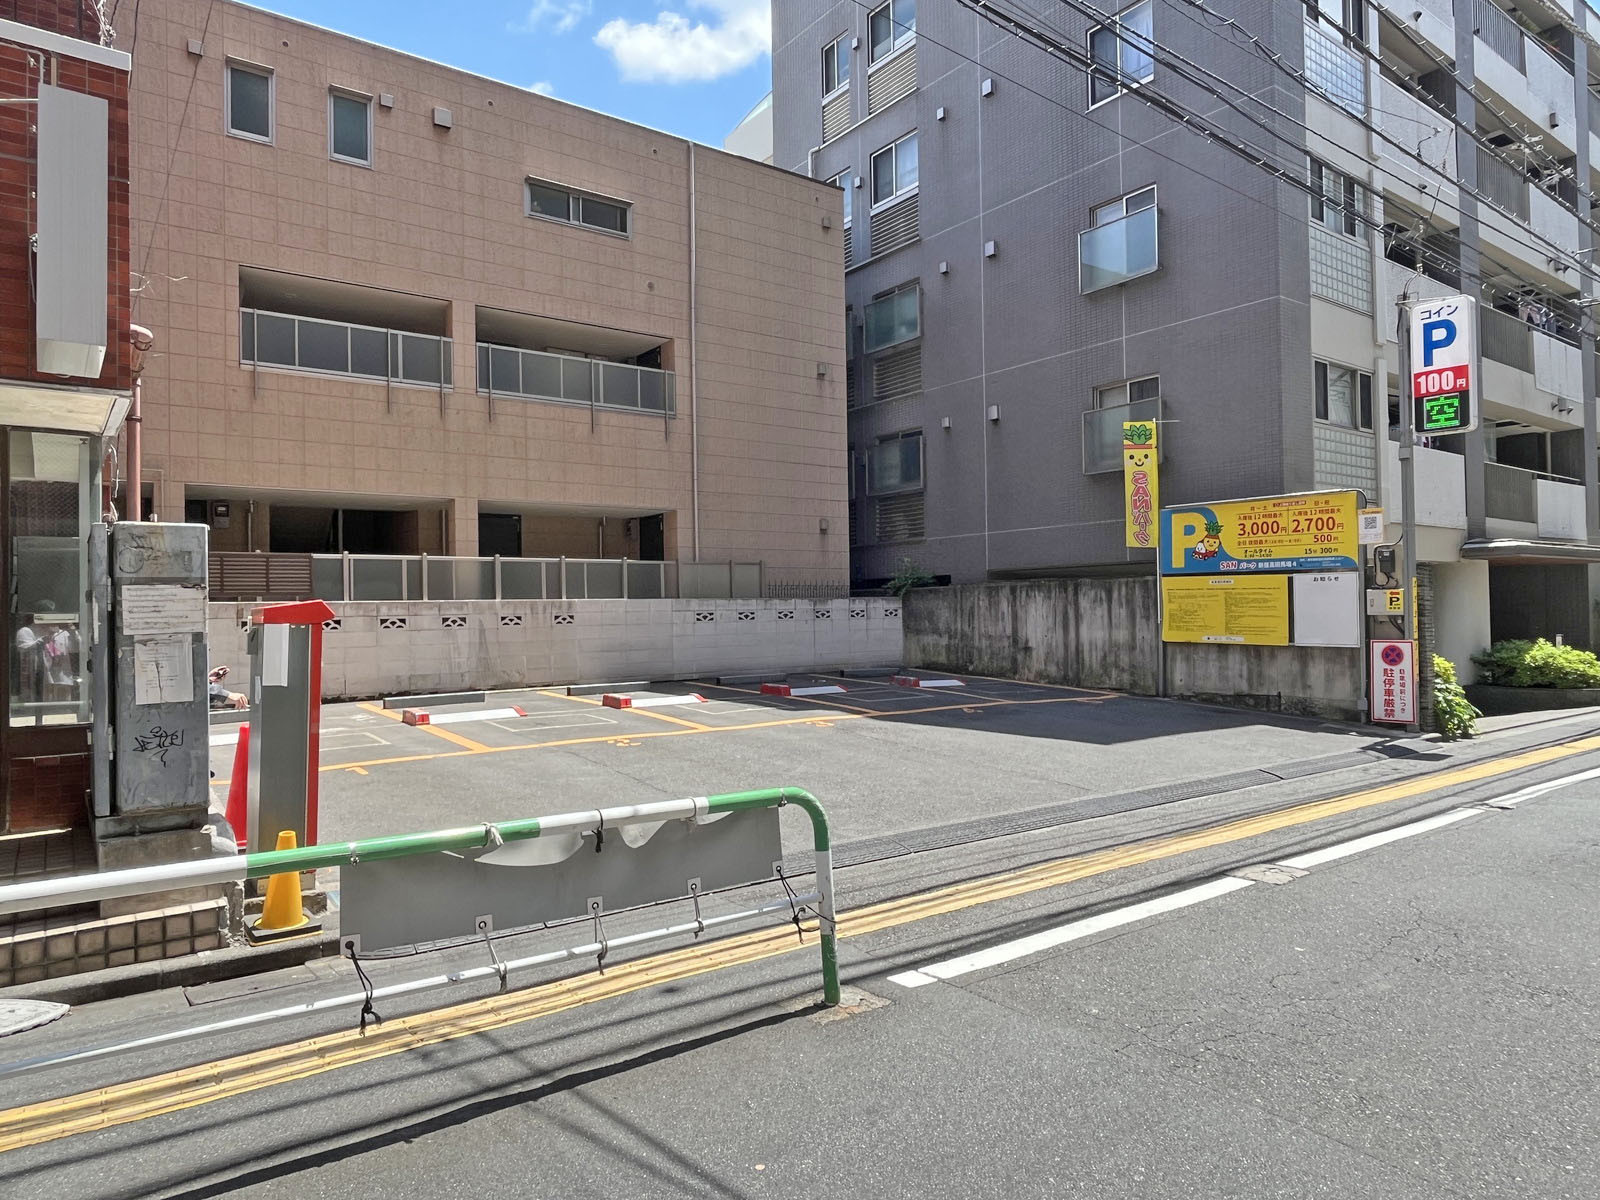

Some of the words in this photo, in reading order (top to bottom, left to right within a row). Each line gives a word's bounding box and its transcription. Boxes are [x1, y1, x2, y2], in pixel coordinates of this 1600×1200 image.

[1420, 304, 1458, 321] コイン
[1422, 318, 1457, 368] P
[1416, 370, 1467, 395] 100円
[1425, 396, 1460, 429] 空
[1237, 520, 1288, 537] 3,000円
[1291, 516, 1345, 533] 2,700円
[1171, 512, 1208, 569] P
[1219, 560, 1238, 570] SAN
[1312, 575, 1340, 583] お知らせ
[1389, 596, 1401, 606] P
[1382, 667, 1396, 719] 駐停車厳禁
